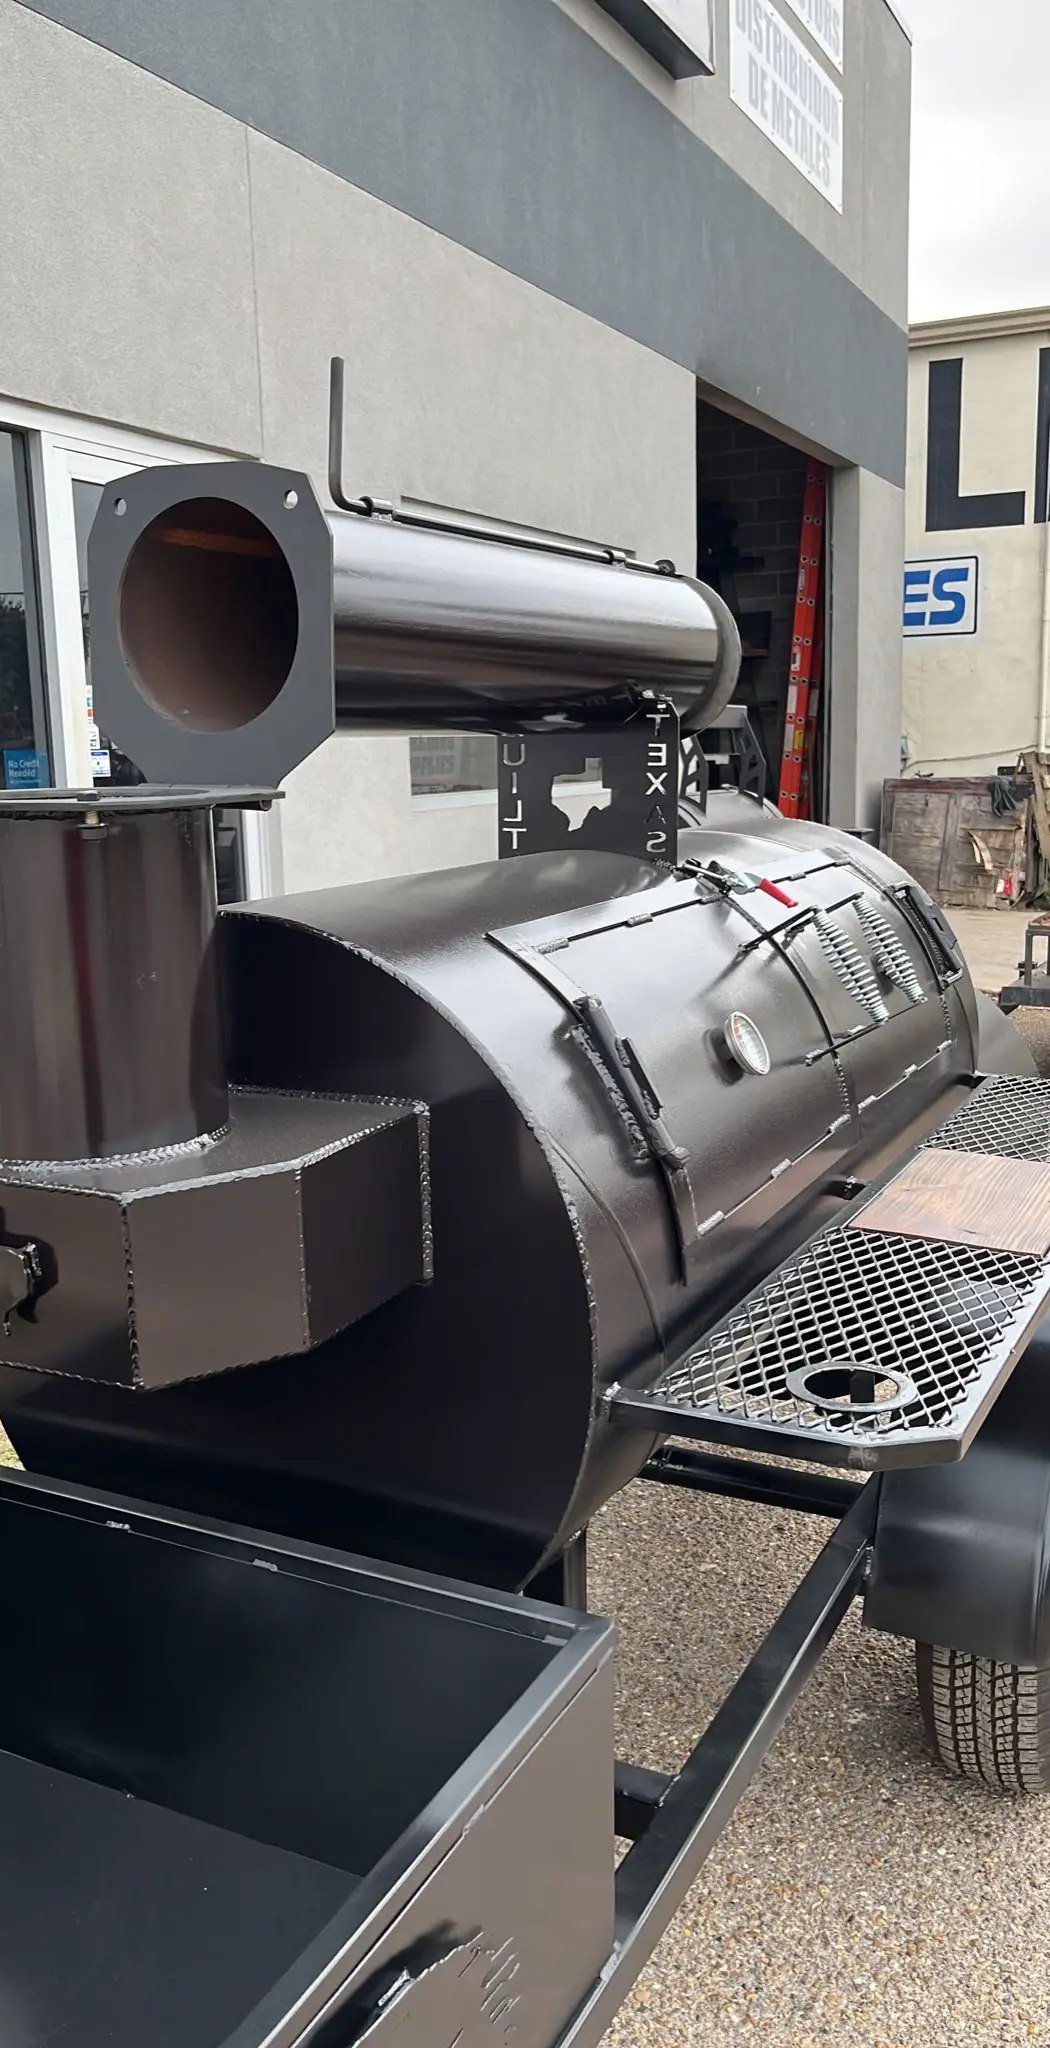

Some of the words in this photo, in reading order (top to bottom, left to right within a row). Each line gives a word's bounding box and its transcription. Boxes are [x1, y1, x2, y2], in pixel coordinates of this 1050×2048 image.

[748, 51, 769, 123] DE
[772, 78, 830, 187] METALES
[8, 760, 18, 769] No
